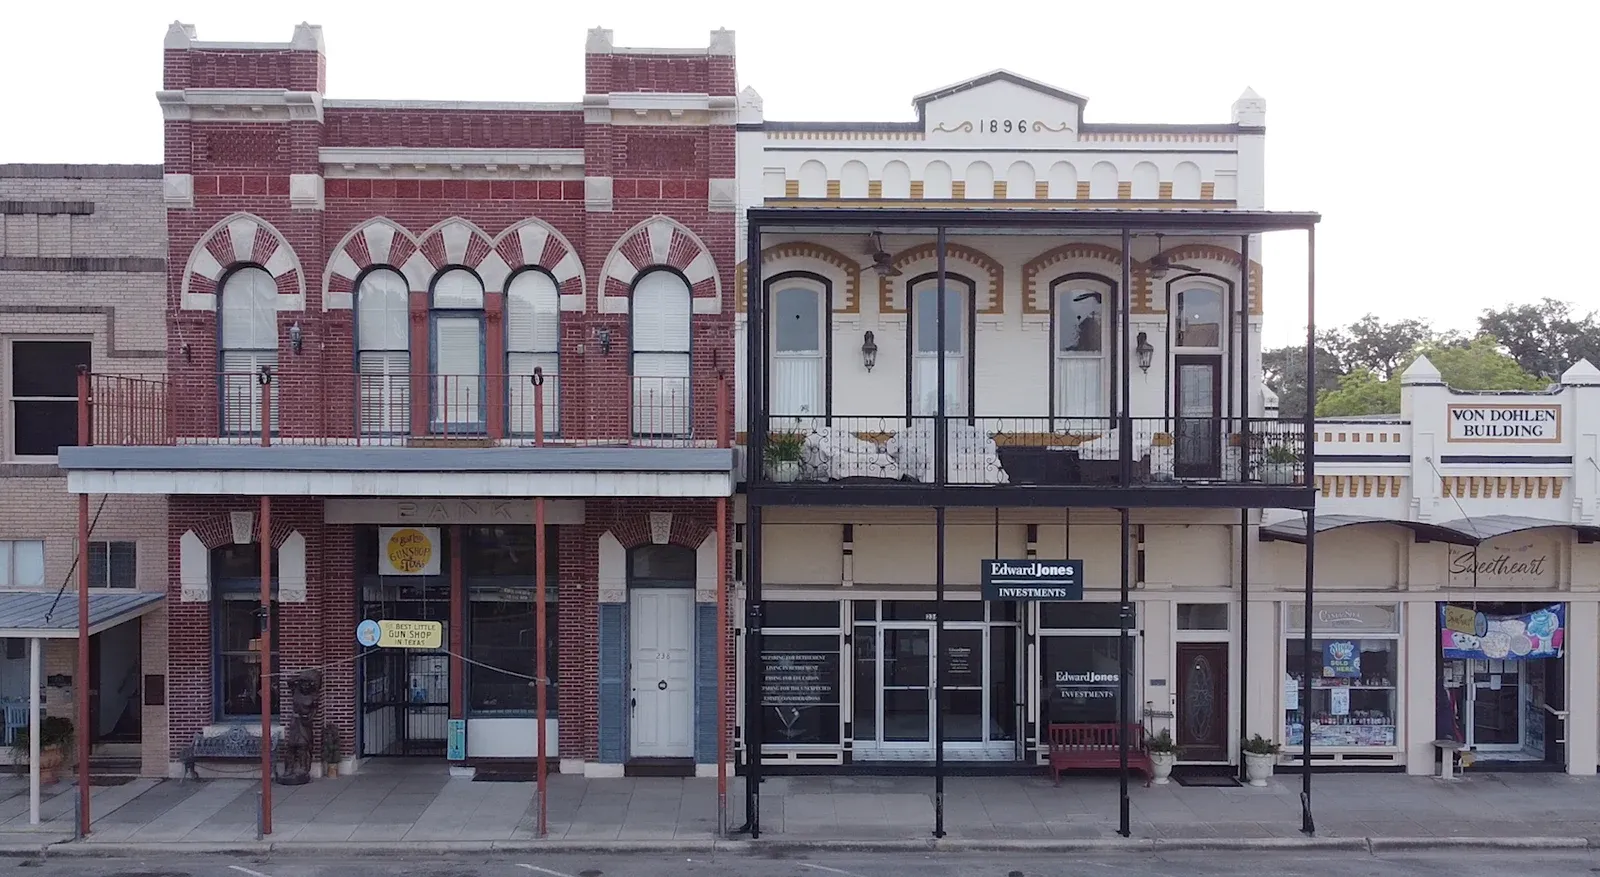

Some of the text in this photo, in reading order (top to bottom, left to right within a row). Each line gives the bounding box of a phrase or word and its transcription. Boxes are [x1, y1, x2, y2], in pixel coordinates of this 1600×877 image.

[980, 119, 1027, 134] 1896
[1452, 409, 1556, 422] VON DOHLEN
[1464, 424, 1543, 437] BUILDING
[397, 501, 512, 520] BANK
[1449, 551, 1547, 576] Sweetheart
[998, 588, 1066, 597] INVESTMENTS
[388, 630, 432, 639] GUN SHOP
[1061, 690, 1114, 698] INVESTMENTS
